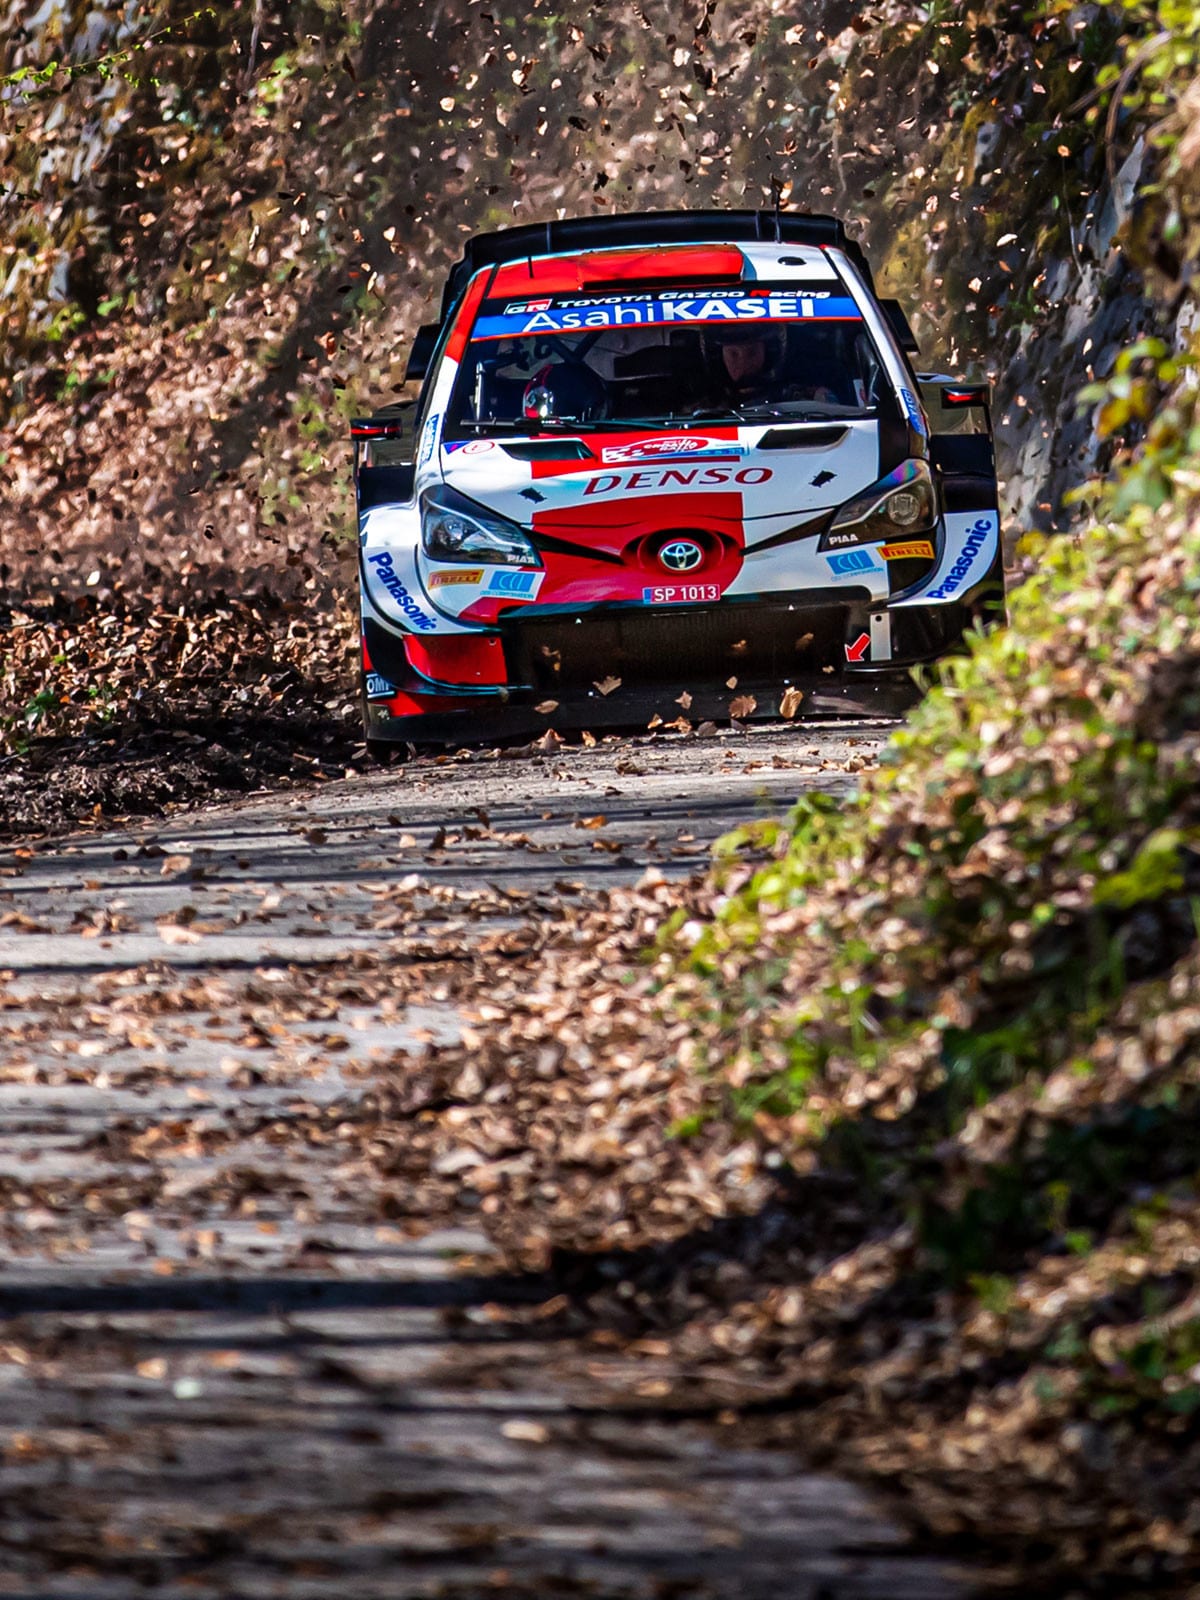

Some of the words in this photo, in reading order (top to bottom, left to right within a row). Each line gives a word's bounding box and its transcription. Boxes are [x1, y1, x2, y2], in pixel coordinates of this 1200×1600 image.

[557, 294, 651, 308] TOYOTA
[658, 290, 745, 301] GAZOO
[750, 289, 831, 299] Racing
[583, 467, 773, 496] DENSO
[829, 534, 858, 545] PIAA
[926, 519, 992, 599] Panasonic
[368, 552, 437, 631] Panasonic
[654, 588, 675, 602] SP
[680, 586, 717, 600] 1013
